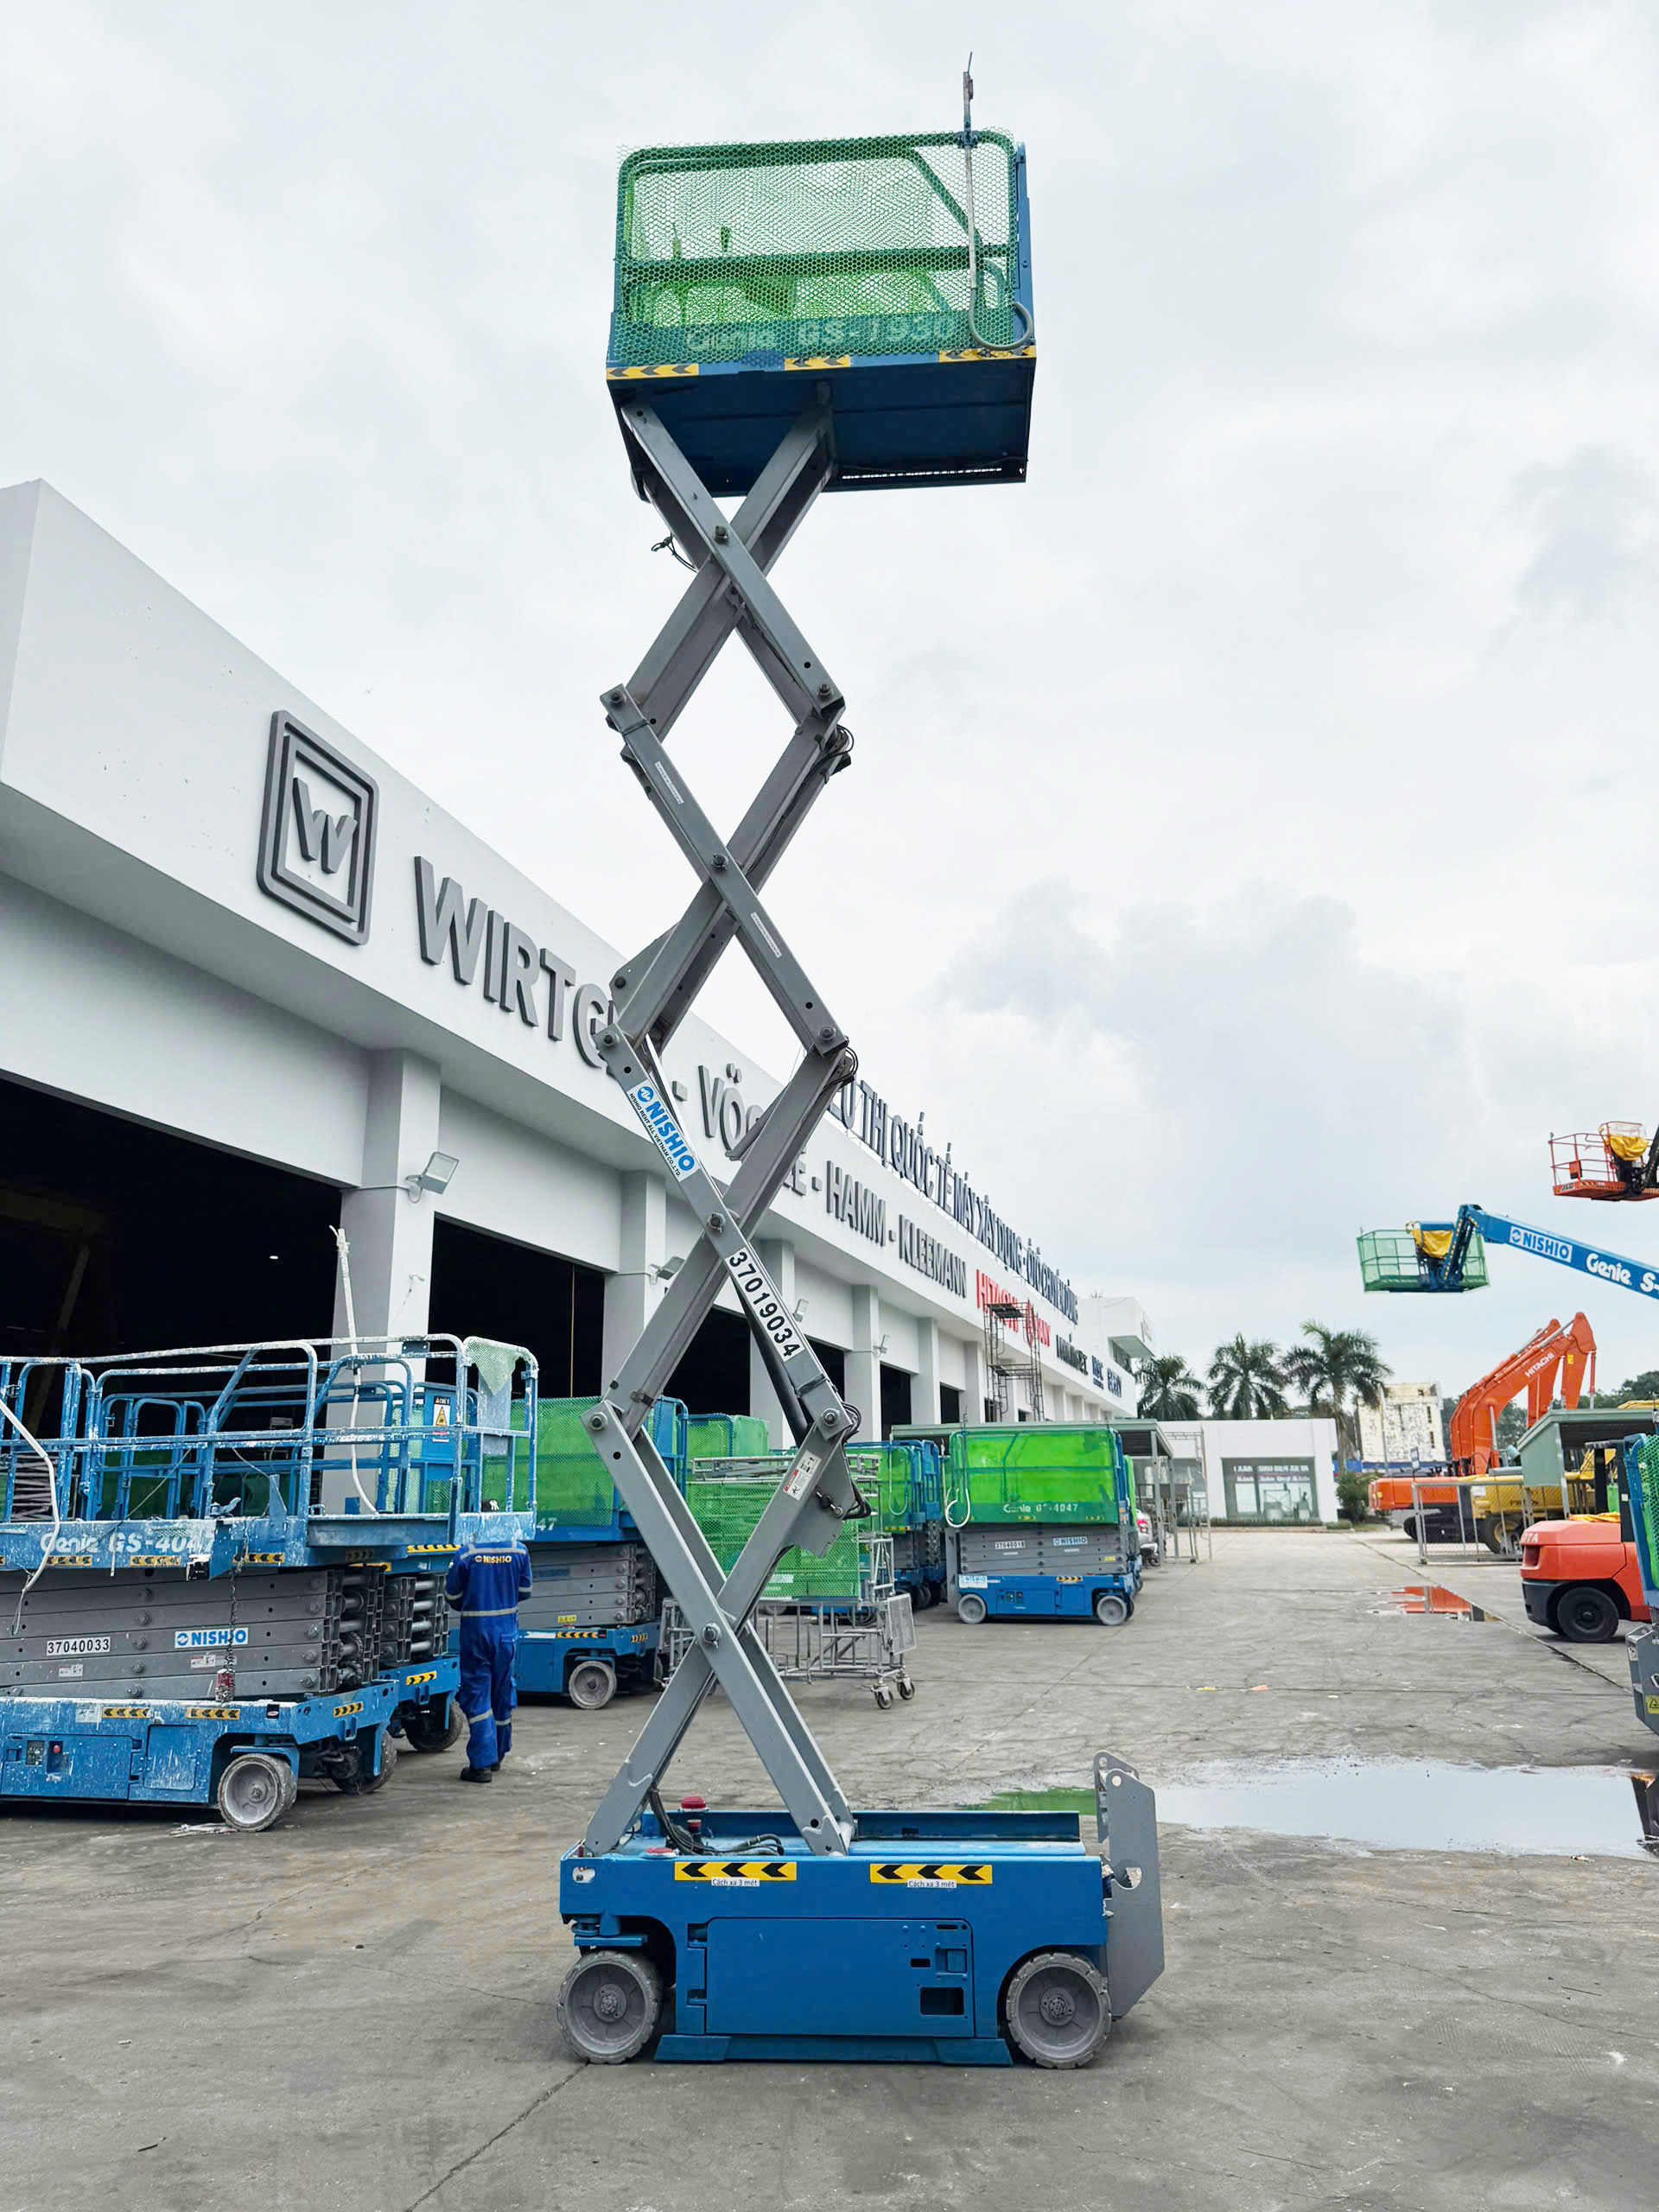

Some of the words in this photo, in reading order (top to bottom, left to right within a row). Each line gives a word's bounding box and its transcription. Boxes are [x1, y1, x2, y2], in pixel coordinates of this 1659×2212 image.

[414, 855, 620, 1070] WIRTG
[827, 1160, 887, 1247] HAMM
[899, 1214, 966, 1299] KLEEMANN
[629, 1093, 642, 1111] NISHIO
[639, 1109, 650, 1124] RENT
[654, 1134, 670, 1157] VIETNAM
[645, 1101, 695, 1171] NISHIO
[891, 1112, 935, 1198] QUỐC
[954, 1172, 976, 1234] MÁY
[1523, 1232, 1570, 1259] NISHIO
[1586, 1253, 1631, 1285] Genie
[729, 1252, 800, 1357] 37019034
[1525, 1352, 1554, 1376] HITACHI
[41, 1532, 99, 1553] Genie
[483, 1554, 512, 1563] NISHIO
[48, 1641, 110, 1654] 37040033
